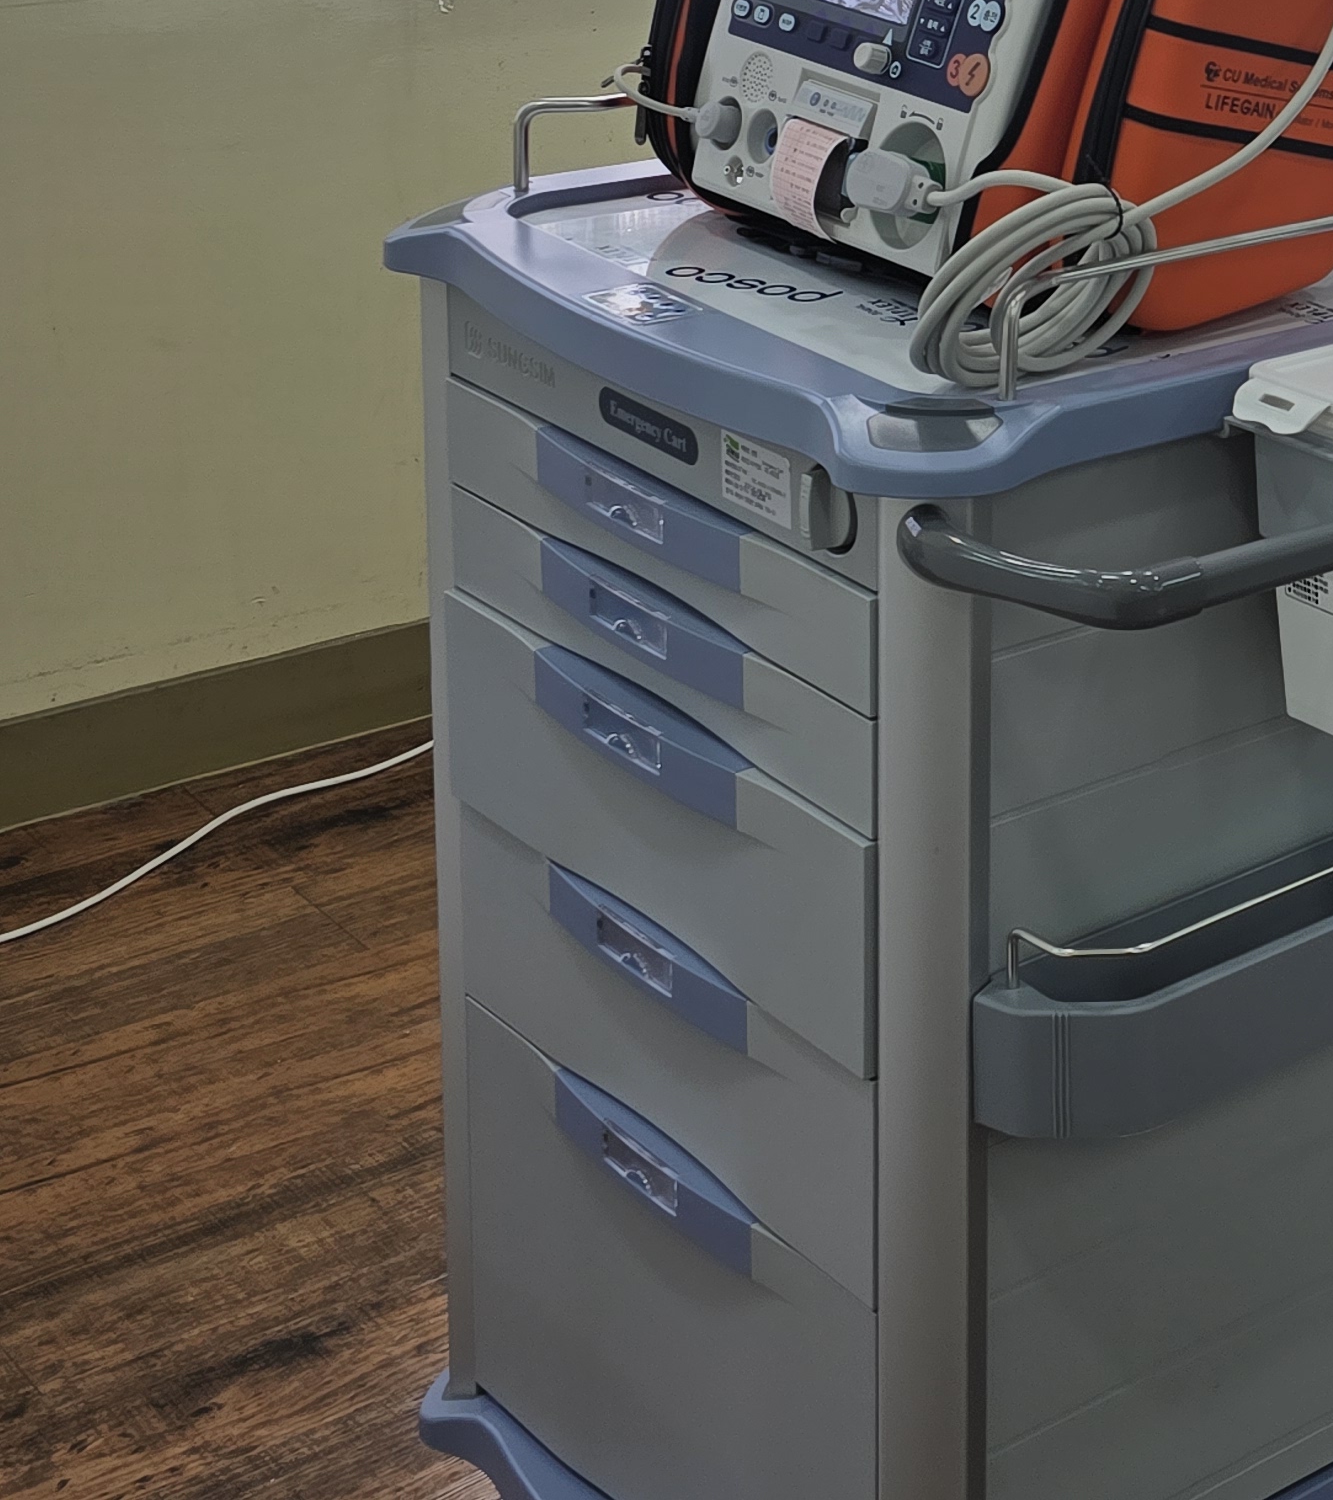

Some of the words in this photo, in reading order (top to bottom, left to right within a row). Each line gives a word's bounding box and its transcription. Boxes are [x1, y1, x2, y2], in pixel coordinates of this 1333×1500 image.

[969, 3, 981, 21] 2
[949, 59, 960, 79] 3
[1222, 68, 1242, 84] CU
[1242, 72, 1288, 93] Medical
[1204, 93, 1277, 119] LIFEGAIN
[664, 265, 844, 304] posco
[609, 399, 662, 443] Emergency
[663, 426, 688, 453] Cart
